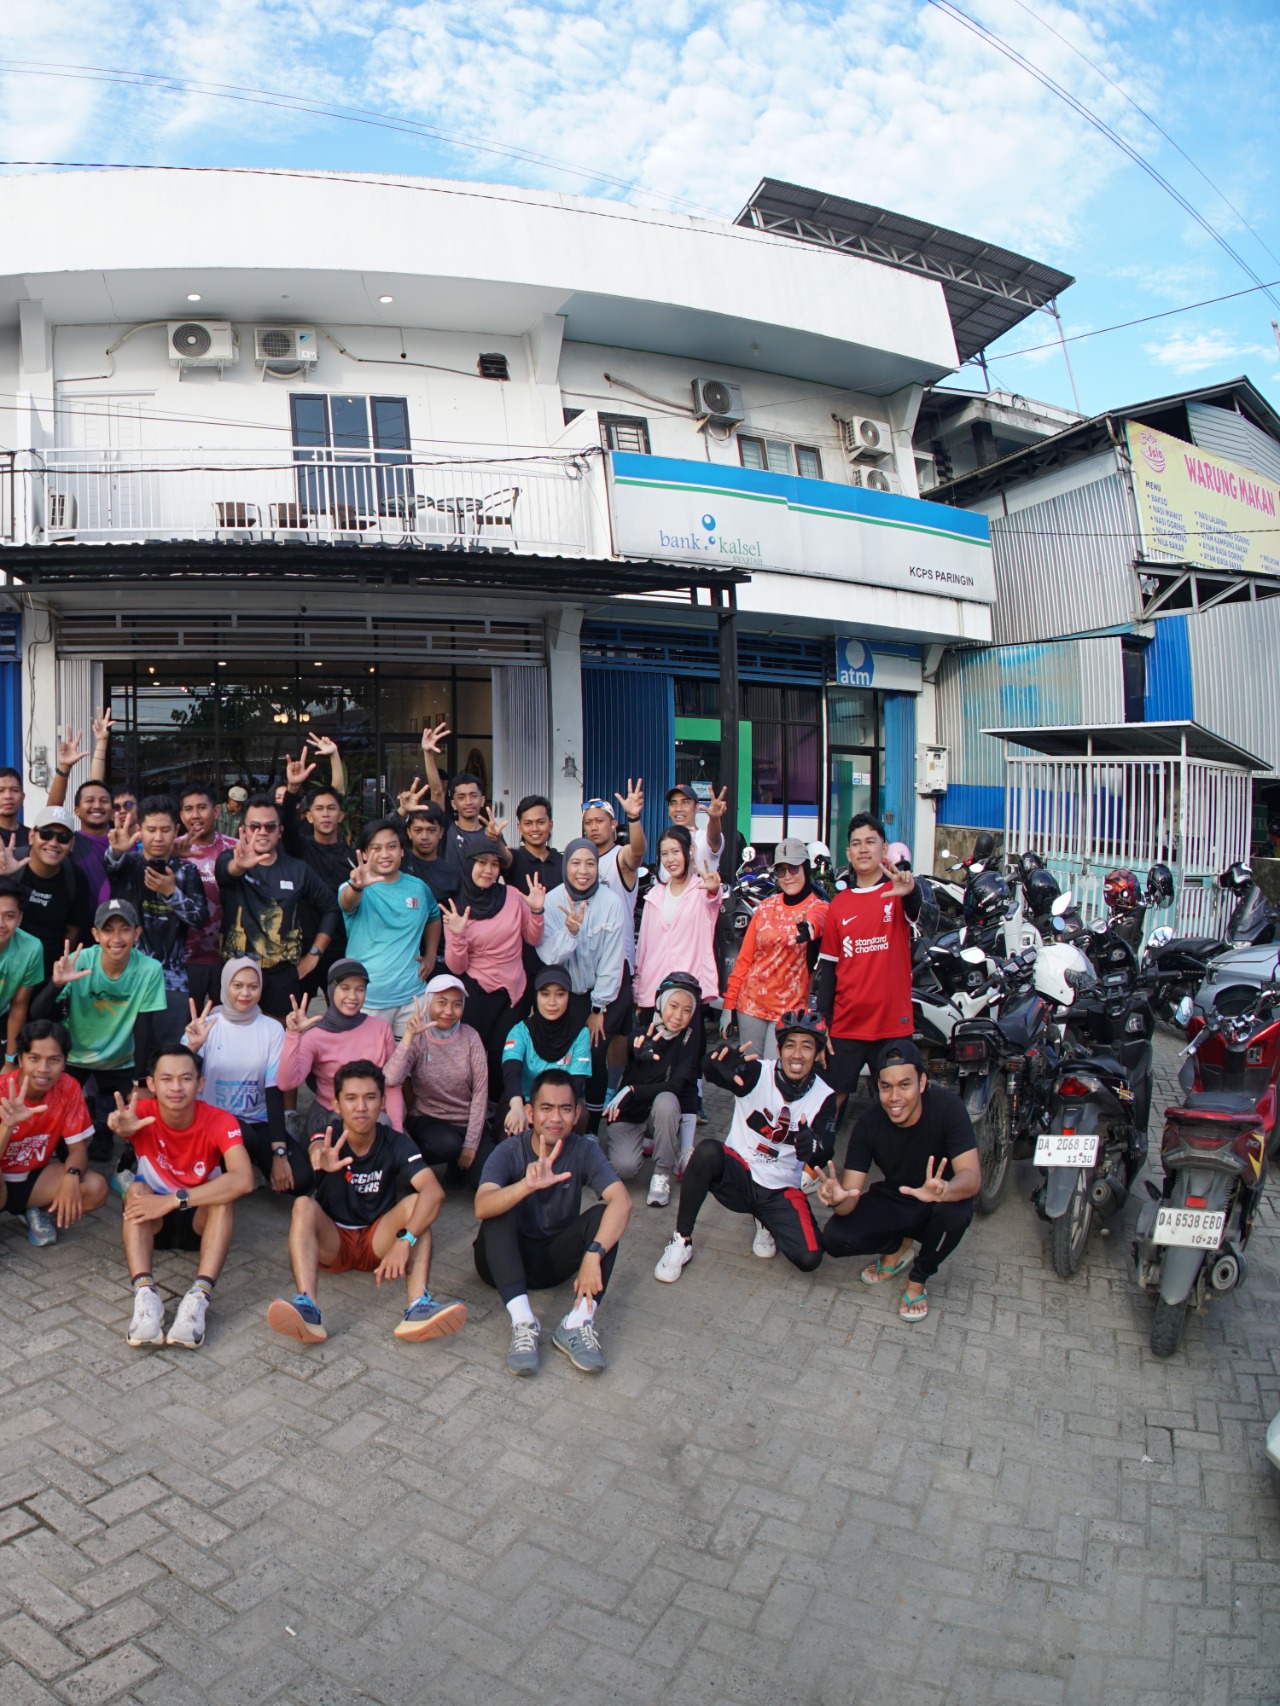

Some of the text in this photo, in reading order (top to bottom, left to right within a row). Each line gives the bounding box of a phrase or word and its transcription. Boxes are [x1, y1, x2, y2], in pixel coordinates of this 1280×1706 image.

[1145, 480, 1162, 492] MENU
[1184, 454, 1276, 517] WARUNG MAKAN
[659, 530, 762, 557] bank kalsel
[909, 566, 974, 586] KCPS PARINGIN
[839, 666, 871, 687] atm
[854, 942, 889, 954] chartered
[855, 935, 887, 947] standard
[1037, 1138, 1050, 1150] DA
[1158, 1212, 1222, 1230] DA 6538 EBD
